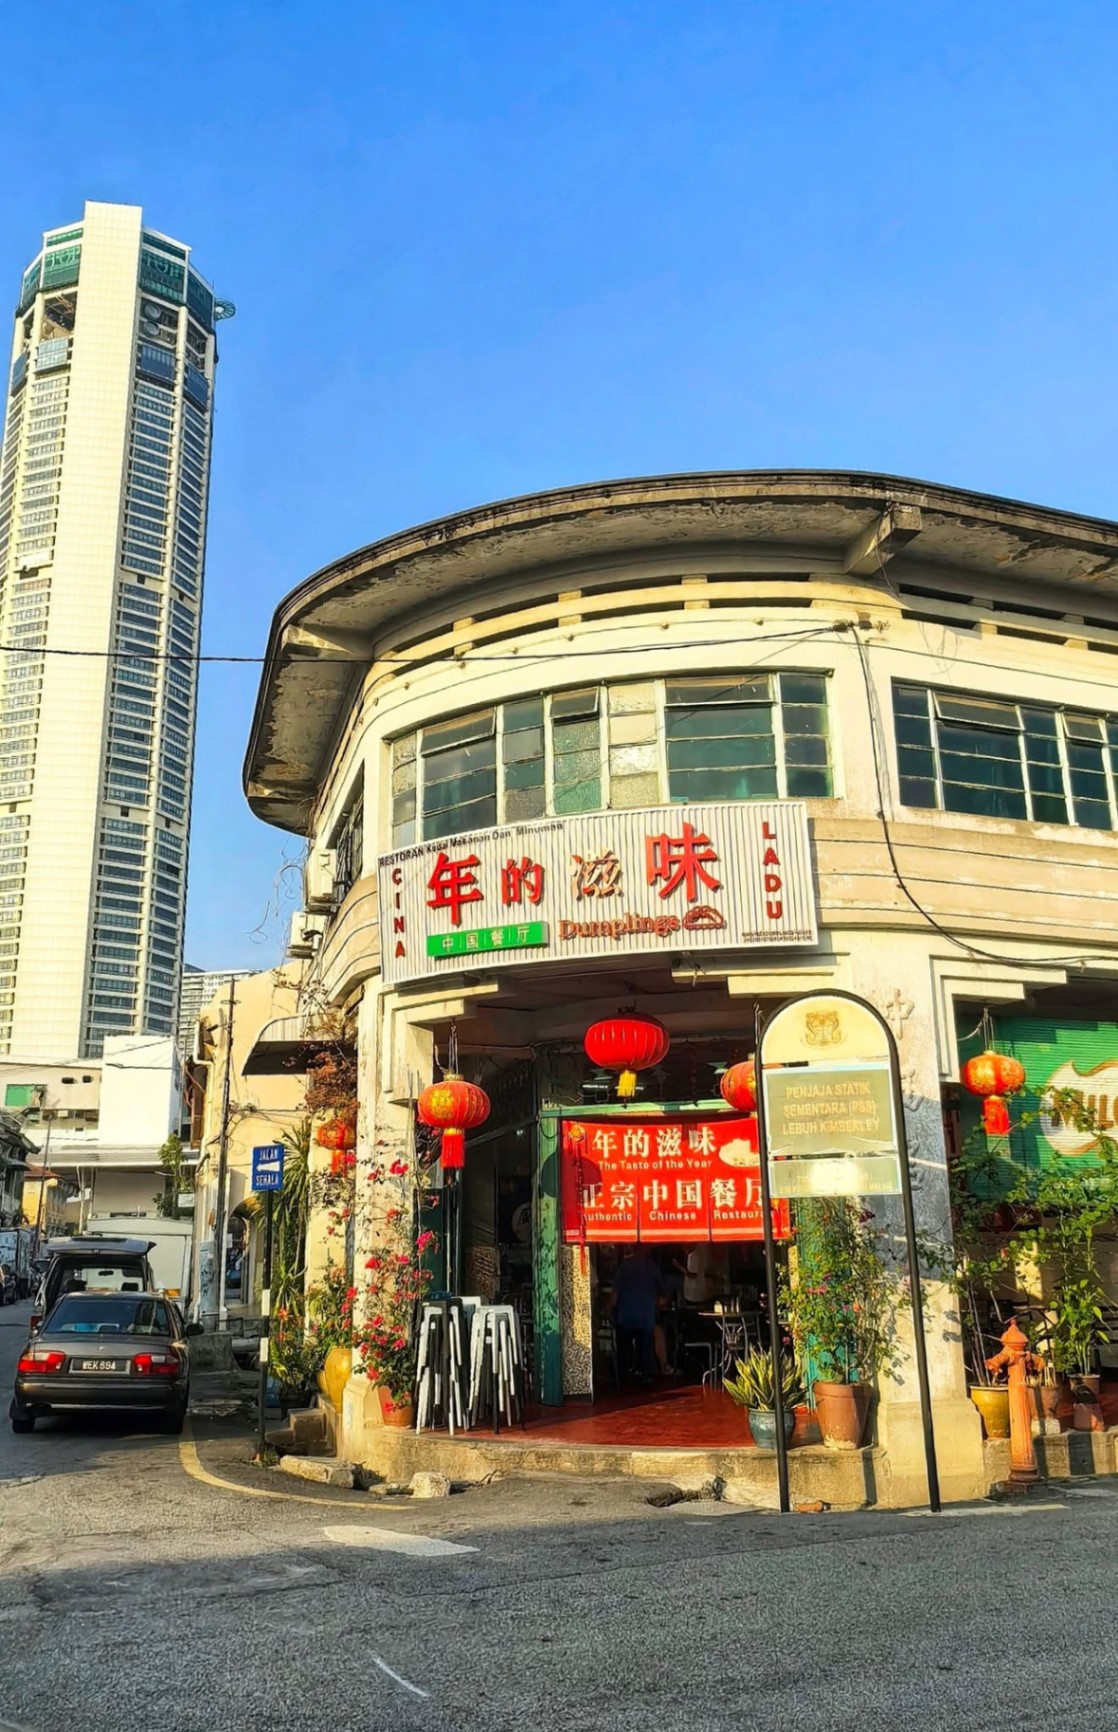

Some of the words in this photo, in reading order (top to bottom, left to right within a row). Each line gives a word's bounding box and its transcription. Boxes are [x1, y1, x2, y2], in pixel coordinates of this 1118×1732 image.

[379, 848, 424, 867] RESTORAN
[492, 829, 511, 840] Dan
[516, 823, 563, 836] Minuman
[427, 821, 721, 928] 年的滋味
[761, 821, 783, 919] LADU
[392, 868, 406, 958] CINA
[559, 912, 680, 941] Dumplings
[443, 926, 530, 952] 中国餐厅
[786, 1085, 833, 1098] PENJAJA
[834, 1081, 871, 1096] STATIK
[783, 1102, 847, 1118] SEMENTARA
[1051, 1088, 1118, 1129] MIL
[783, 1121, 817, 1134] LEBUH
[820, 1117, 879, 1132] KIMBERLEY
[592, 1126, 716, 1158] 年的滋味
[599, 1160, 617, 1170] The
[621, 1160, 649, 1170] Taste
[652, 1160, 663, 1169] of
[666, 1160, 684, 1169] the
[687, 1158, 712, 1168] Year
[583, 1211, 632, 1221] uthentic
[649, 1210, 697, 1221] Chinese
[714, 1210, 764, 1220] Restaur
